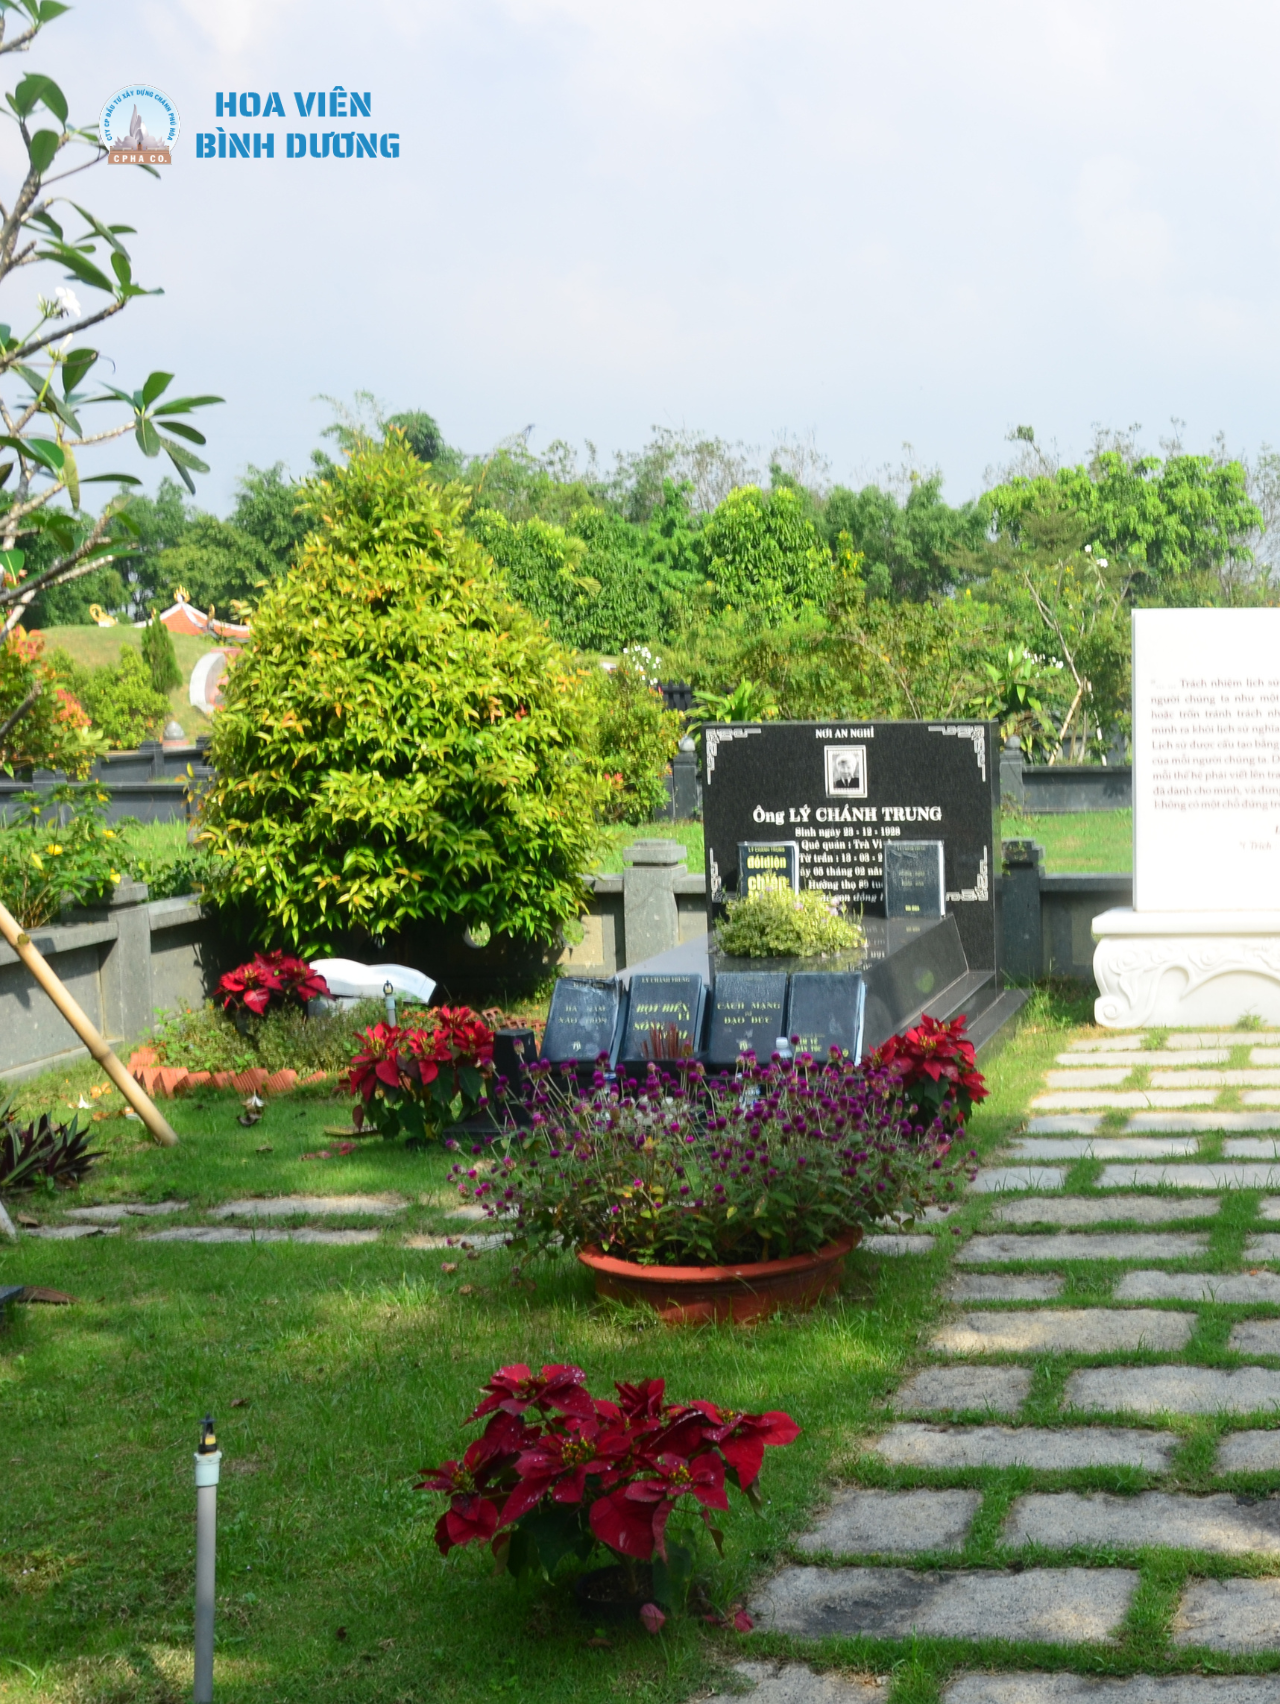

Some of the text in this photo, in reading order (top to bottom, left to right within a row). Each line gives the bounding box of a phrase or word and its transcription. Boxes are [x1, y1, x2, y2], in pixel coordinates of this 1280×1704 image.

[834, 728, 848, 738] AN
[752, 804, 942, 825] Ông LÝ CHÁNH TRUNG
